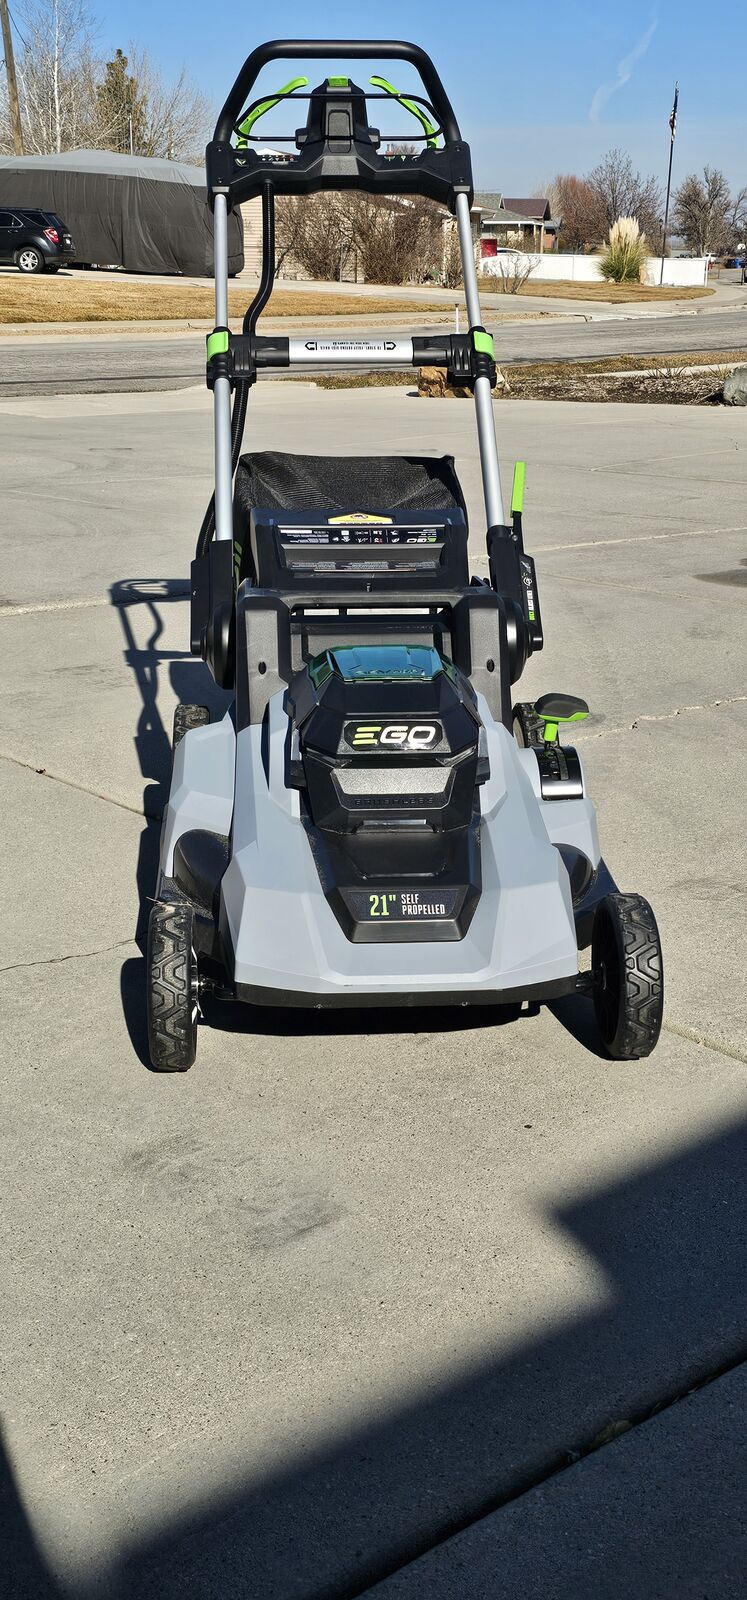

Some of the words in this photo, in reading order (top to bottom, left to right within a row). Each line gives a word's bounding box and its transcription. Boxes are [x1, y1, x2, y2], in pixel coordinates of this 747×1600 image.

[352, 725, 436, 745] EGO
[369, 894, 397, 916] 21"
[401, 893, 419, 904] SELF
[402, 904, 446, 915] PROPELLED
